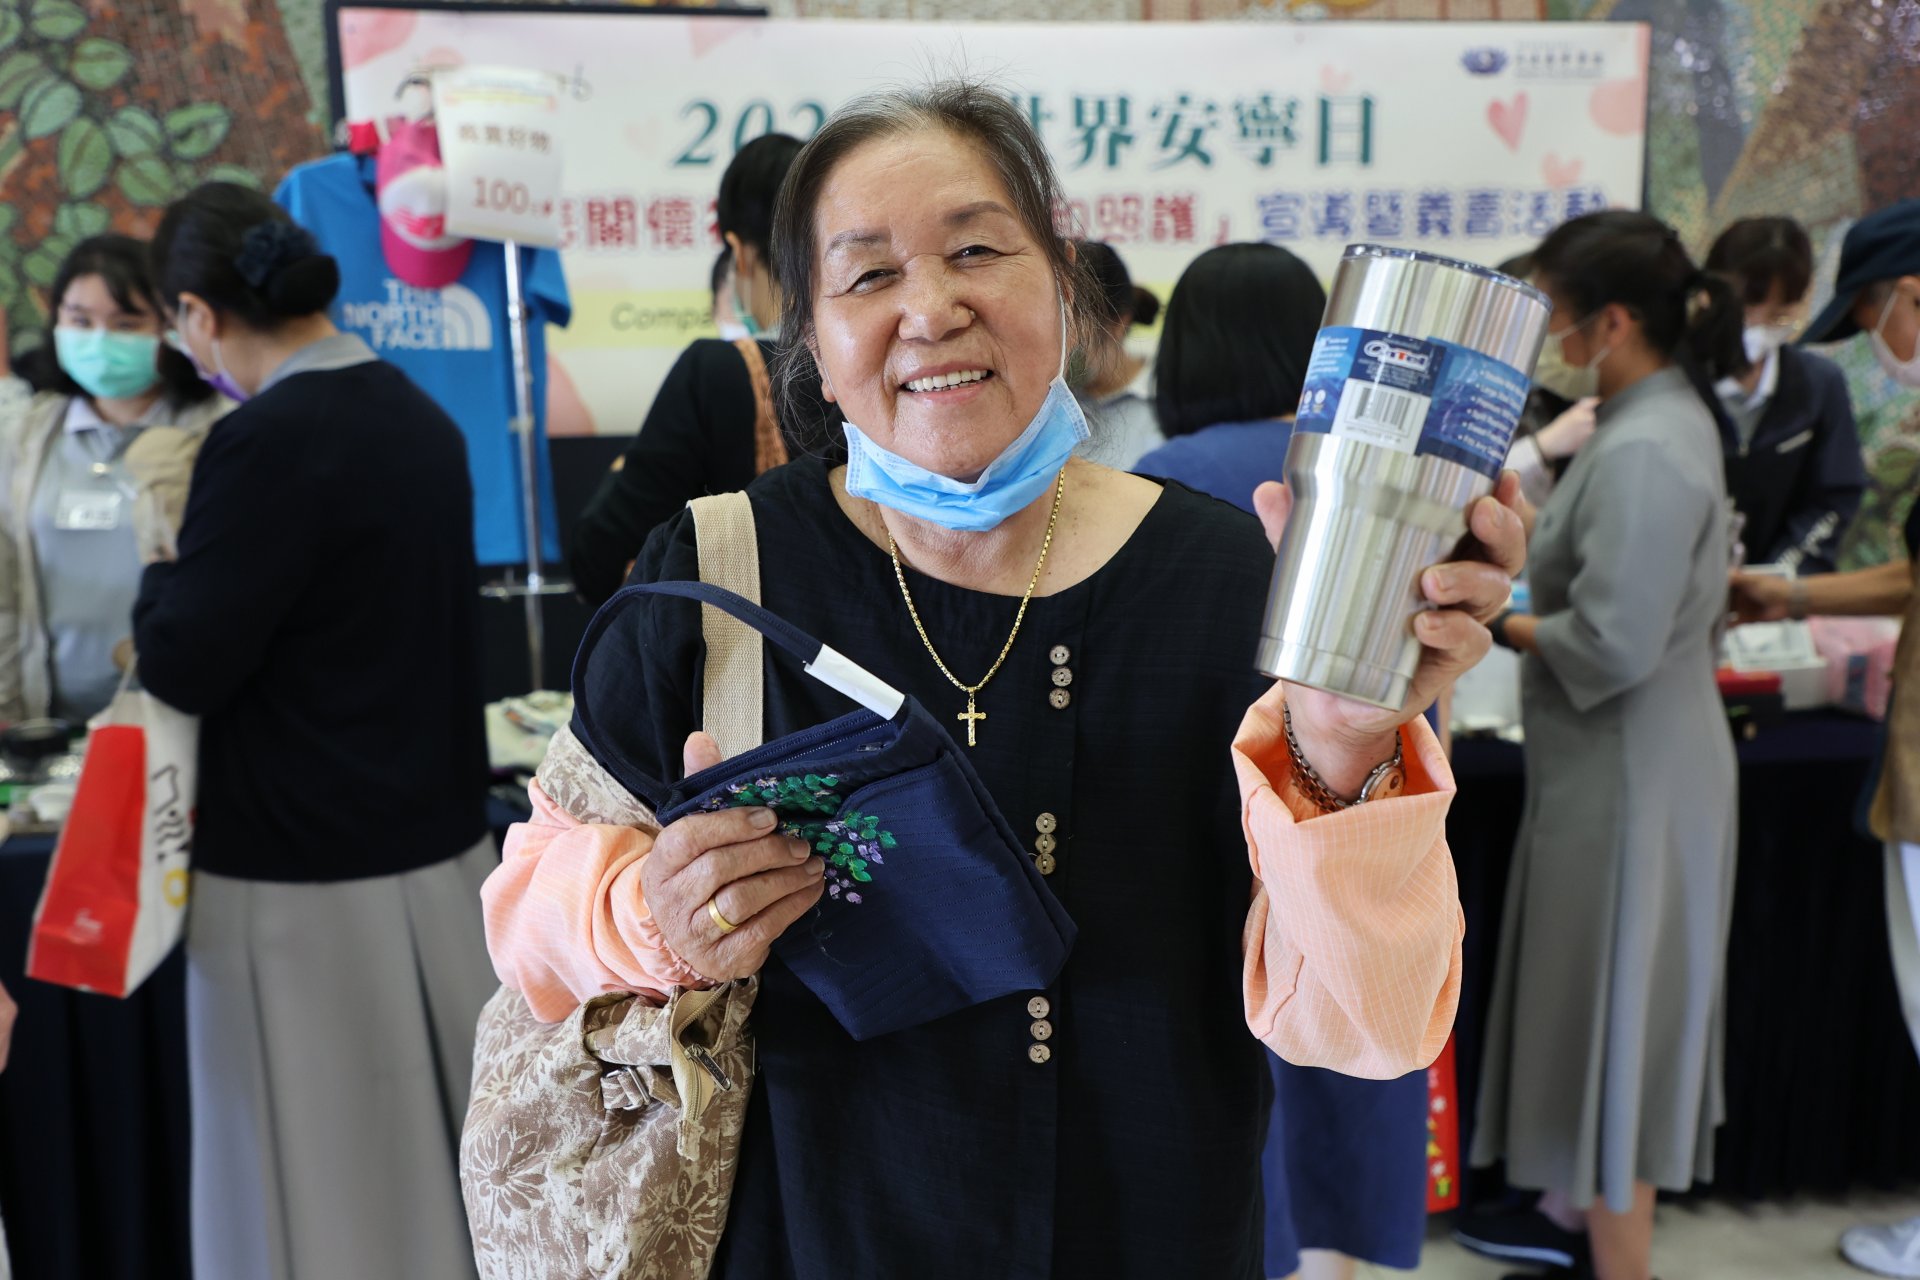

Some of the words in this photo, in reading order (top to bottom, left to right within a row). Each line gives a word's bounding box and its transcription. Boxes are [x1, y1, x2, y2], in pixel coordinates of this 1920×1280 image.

[561, 196, 722, 246] 關懷
[344, 302, 445, 327] NORTH
[372, 327, 444, 350] FACE
